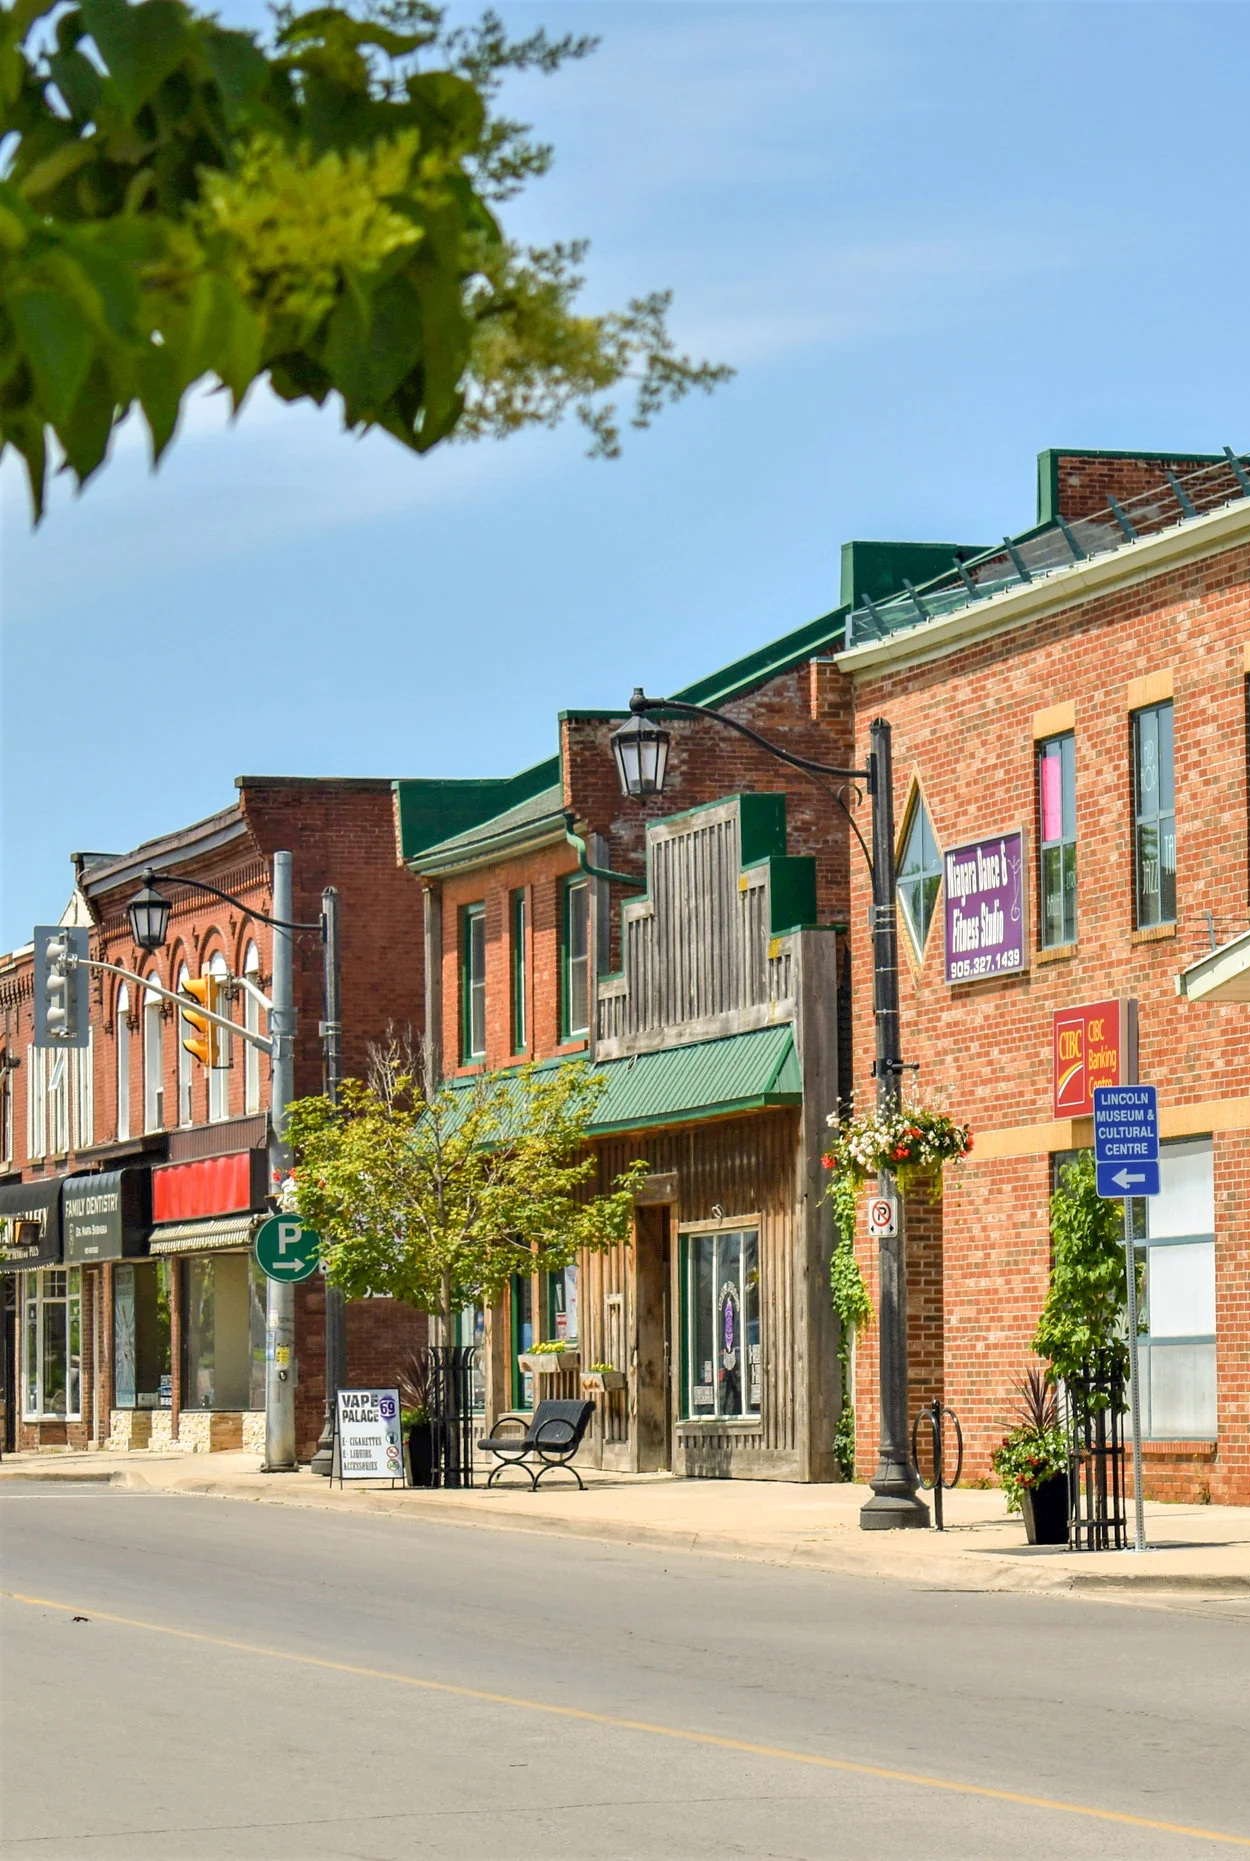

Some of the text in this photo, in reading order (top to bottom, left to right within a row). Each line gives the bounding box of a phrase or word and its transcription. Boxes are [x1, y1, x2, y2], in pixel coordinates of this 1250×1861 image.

[946, 853, 978, 907] Niagara
[977, 846, 1001, 893] Dance
[952, 907, 980, 954] Fitness
[980, 898, 1005, 948] Studio
[950, 948, 1021, 979] 905.327.1439
[1087, 1018, 1105, 1044] CIBC
[1059, 1028, 1083, 1061] CIBC
[1088, 1046, 1117, 1072] Banking
[1101, 1092, 1149, 1106] LINCOLN
[1096, 1108, 1155, 1123] MUSEUM &
[1098, 1126, 1155, 1139] CULTURAL
[1105, 1142, 1149, 1156] CENTRE
[65, 1193, 119, 1218] FAMILY DENTISTRY
[278, 1222, 303, 1255] P
[341, 1394, 380, 1408] VAPE
[380, 1401, 396, 1415] 69
[342, 1409, 380, 1423] PALACE
[350, 1436, 382, 1447] CIGARETTES
